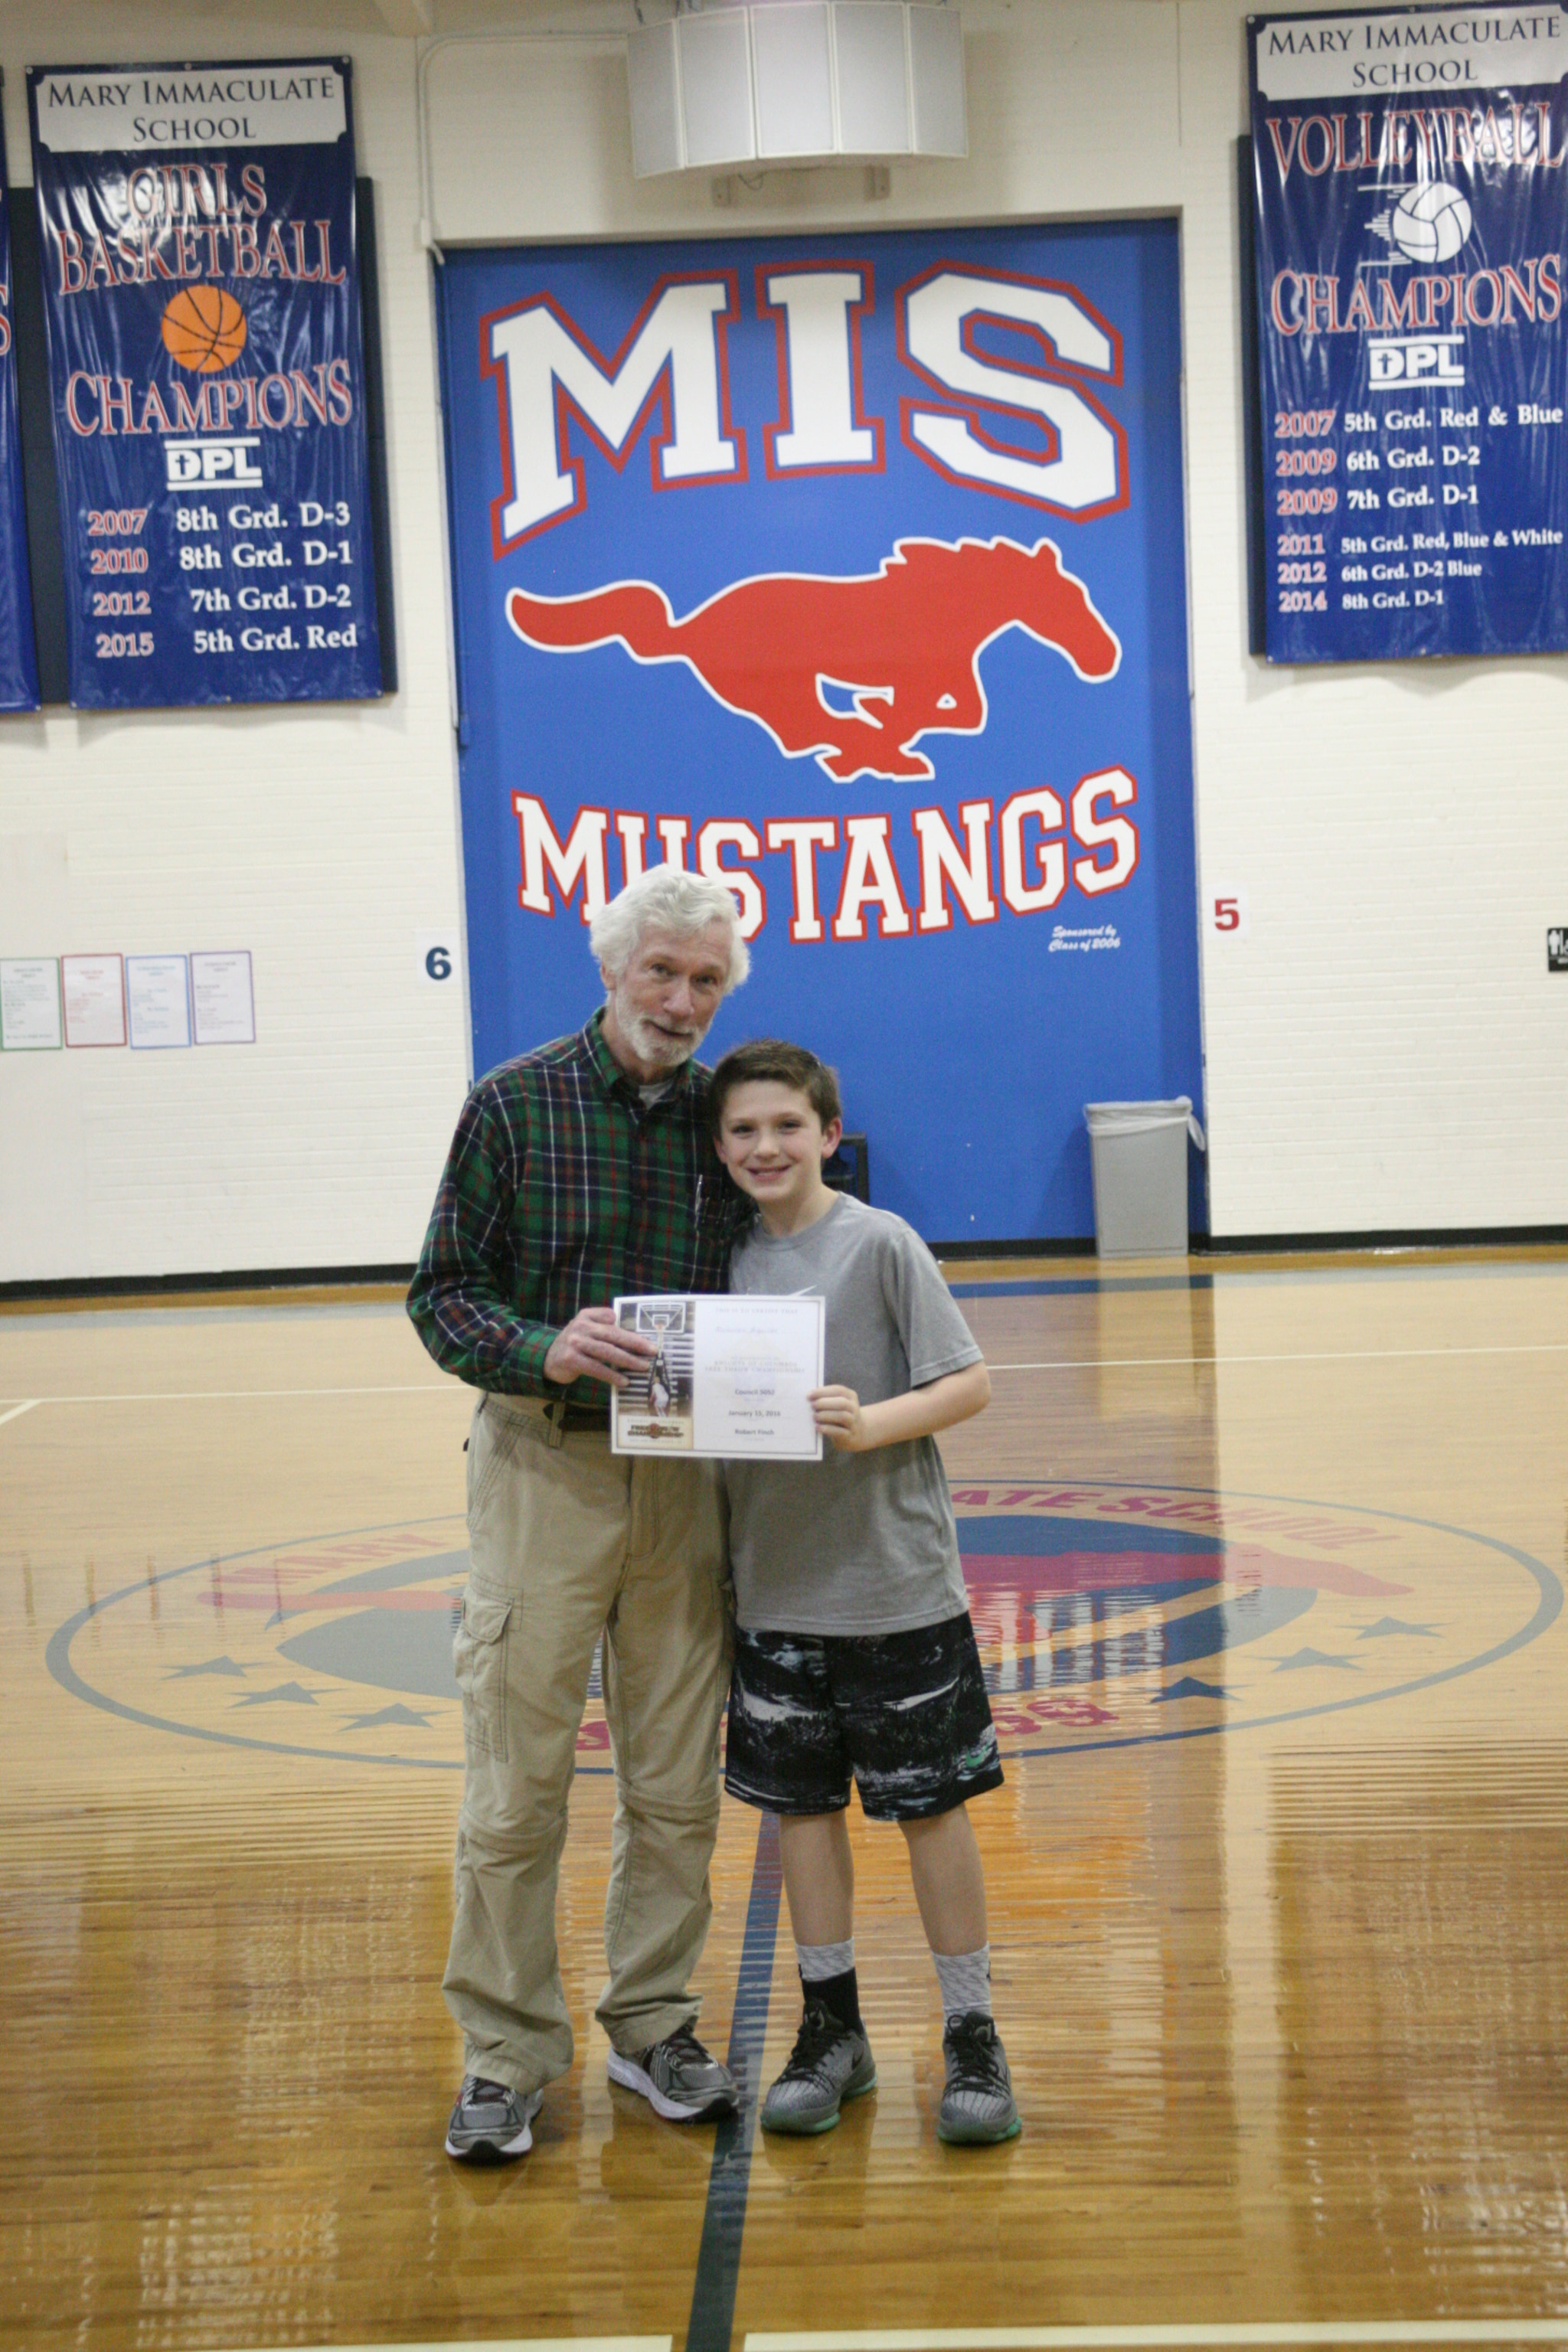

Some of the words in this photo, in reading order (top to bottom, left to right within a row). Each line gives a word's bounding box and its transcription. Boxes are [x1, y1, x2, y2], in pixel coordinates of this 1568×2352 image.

[1269, 28, 1354, 56] MARY
[1366, 15, 1561, 50] IMMACULATE
[1353, 59, 1478, 88] SCHOOL
[48, 82, 131, 108] MARY
[143, 77, 335, 104] IMMACULATE
[133, 116, 257, 142] SCHOOL
[1266, 102, 1566, 182] VOLLEYBALL
[126, 163, 267, 219] GIRLS
[57, 220, 347, 296] BASKETBALL
[1271, 253, 1562, 335] CHAMPIONS
[1369, 344, 1464, 381] DPL
[66, 358, 353, 436] CHAMPIONS
[479, 259, 1131, 562] MIS
[1275, 410, 1336, 438] 2007
[1344, 412, 1377, 433] 5th
[1385, 409, 1432, 430] Grd.
[1440, 407, 1478, 428] Red
[1488, 406, 1508, 426] &
[1517, 404, 1563, 425] Blue
[166, 446, 262, 482] DPL
[1276, 448, 1337, 476] 2009
[1346, 450, 1380, 472] 6th
[1387, 447, 1434, 469] Grd.
[1442, 446, 1481, 466] D-2
[1277, 488, 1338, 515] 2009
[1347, 489, 1380, 511] 7th
[1387, 486, 1434, 508] Grd.
[1442, 485, 1478, 505] D-1
[87, 508, 149, 536] 2007
[176, 505, 218, 532] 8th
[229, 504, 289, 531] Grd.
[299, 501, 351, 528] D-3
[90, 547, 149, 574] 2010
[179, 544, 223, 570] 8th
[232, 542, 292, 569] Grd.
[303, 540, 353, 566] D-1
[1277, 534, 1325, 556] 2011
[1341, 537, 1367, 554] 5th
[1370, 535, 1409, 554] Grd.
[1413, 533, 1449, 550] Red,
[1454, 531, 1489, 548] Blue
[1494, 531, 1508, 547] &
[1513, 530, 1563, 546] White
[1278, 562, 1327, 583] 2012
[1341, 564, 1367, 582] 6th
[1371, 563, 1410, 581] Grd.
[1413, 561, 1444, 577] D-2
[1447, 560, 1482, 577] Blue
[93, 591, 152, 616] 2012
[191, 588, 231, 613] 7th
[238, 586, 297, 612] Grd.
[305, 584, 351, 609] D-2
[1279, 590, 1328, 612] 2014
[1342, 593, 1368, 610] 8th
[1373, 592, 1410, 609] Grd.
[1415, 590, 1444, 606] D-1
[96, 632, 154, 658] 2015
[194, 629, 234, 654] 5th
[240, 626, 299, 652] Grd.
[307, 624, 358, 648] Red
[1105, 923, 1117, 937] by
[1214, 897, 1240, 931] 5
[1048, 939, 1079, 952] Class
[1080, 938, 1092, 952] of
[425, 946, 452, 981] 6
[1096, 1496, 1403, 1550] SCHOOL
